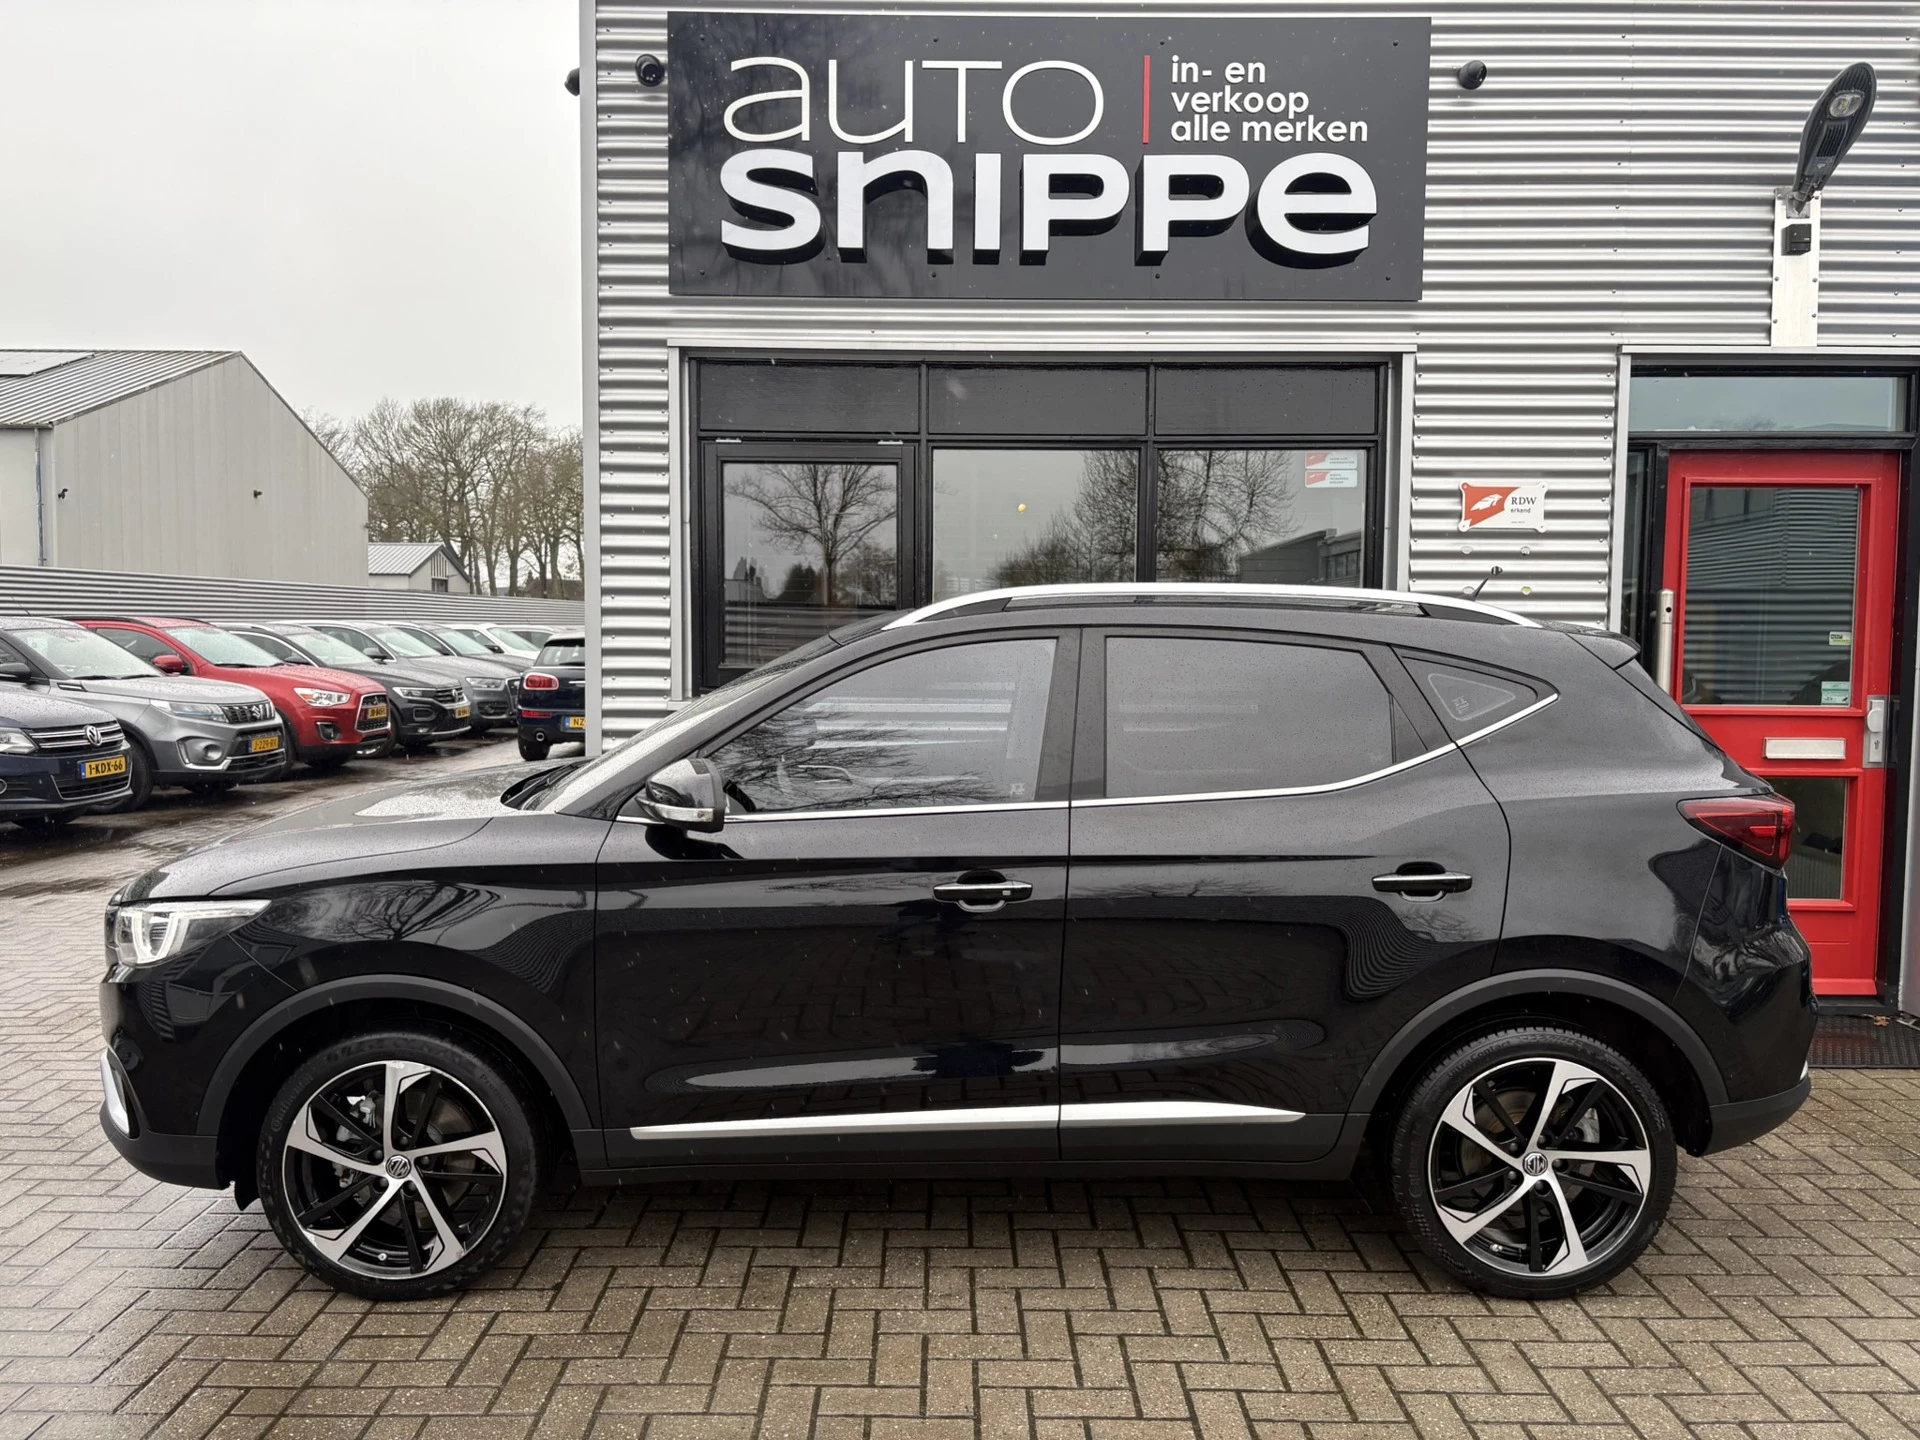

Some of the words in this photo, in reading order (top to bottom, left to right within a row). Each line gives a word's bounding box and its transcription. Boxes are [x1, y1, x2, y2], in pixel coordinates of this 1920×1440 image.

[1171, 54, 1213, 84] in-
[1224, 61, 1266, 84] en
[1170, 84, 1310, 120] verkoop
[1170, 113, 1231, 142] alle
[1241, 114, 1368, 142] merken
[1511, 496, 1537, 506] RDW
[88, 759, 123, 776] 1-KDX-66
